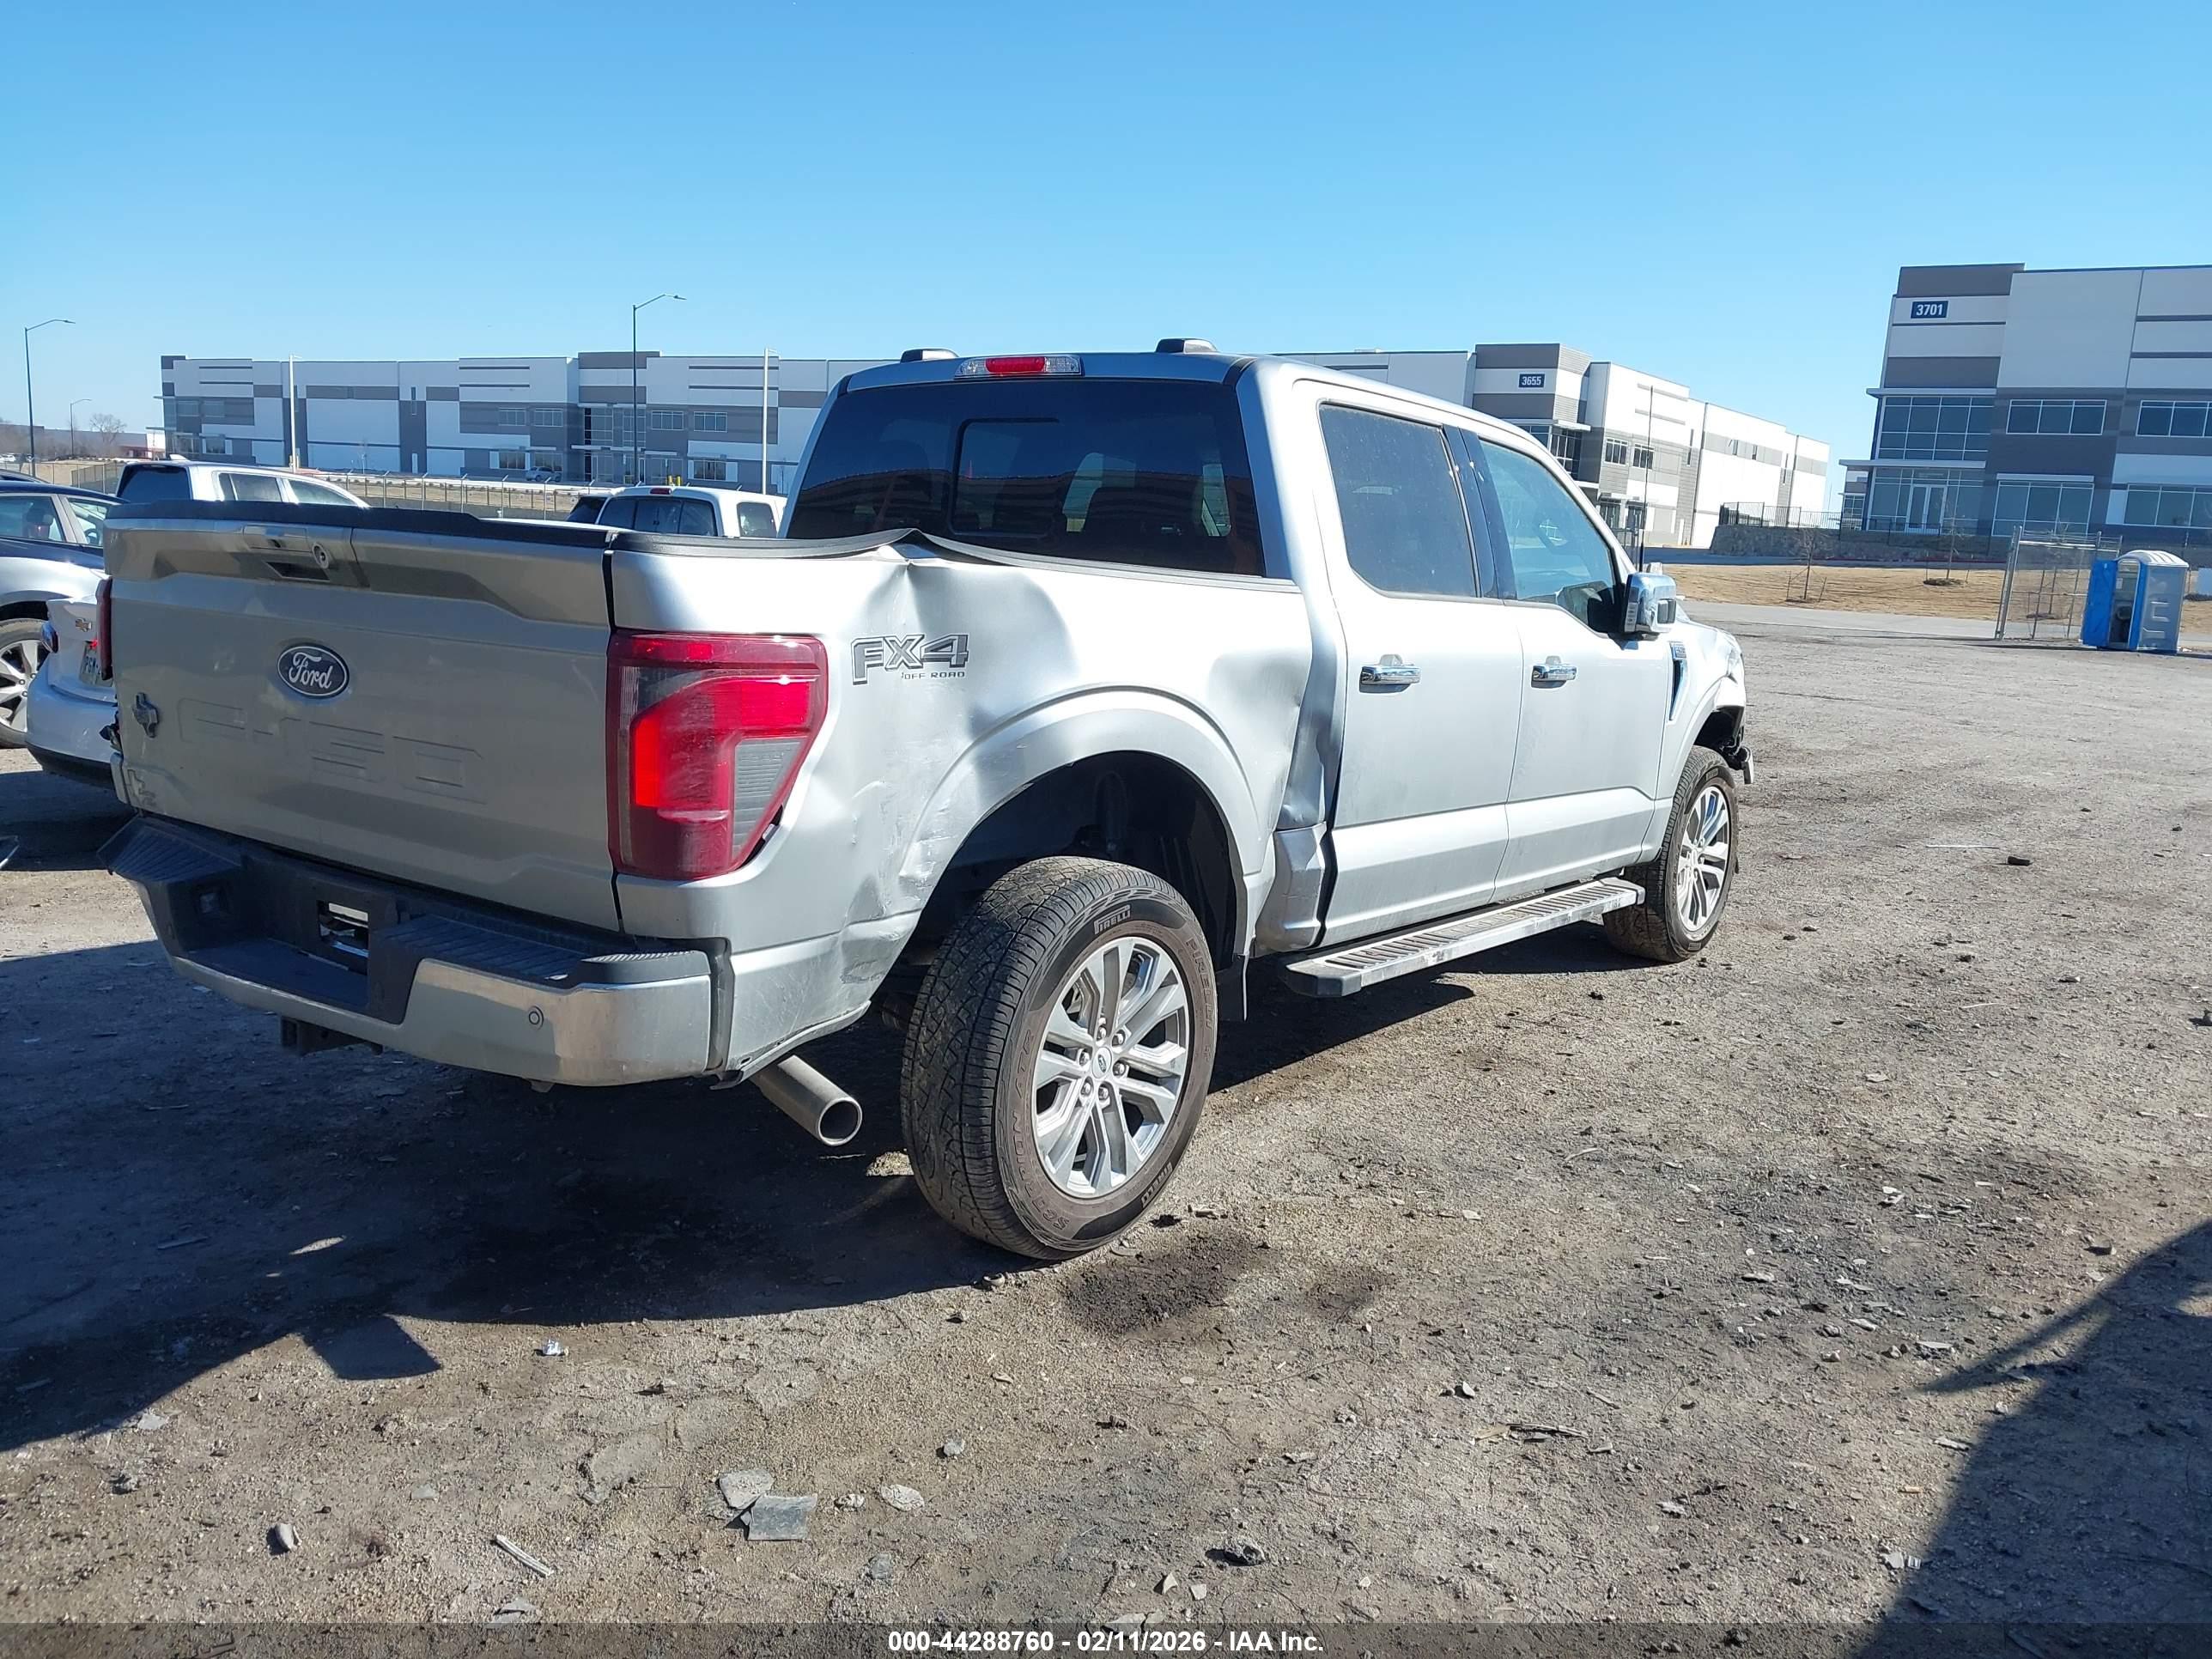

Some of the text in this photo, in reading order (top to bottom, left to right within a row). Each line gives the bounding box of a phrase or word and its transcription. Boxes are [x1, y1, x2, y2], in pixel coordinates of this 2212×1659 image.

[1916, 303, 1943, 316] 3701
[1522, 375, 1542, 386] 3655
[289, 652, 333, 689] Ford
[851, 634, 969, 685] FX4
[1093, 903, 1131, 935] PIRELLI
